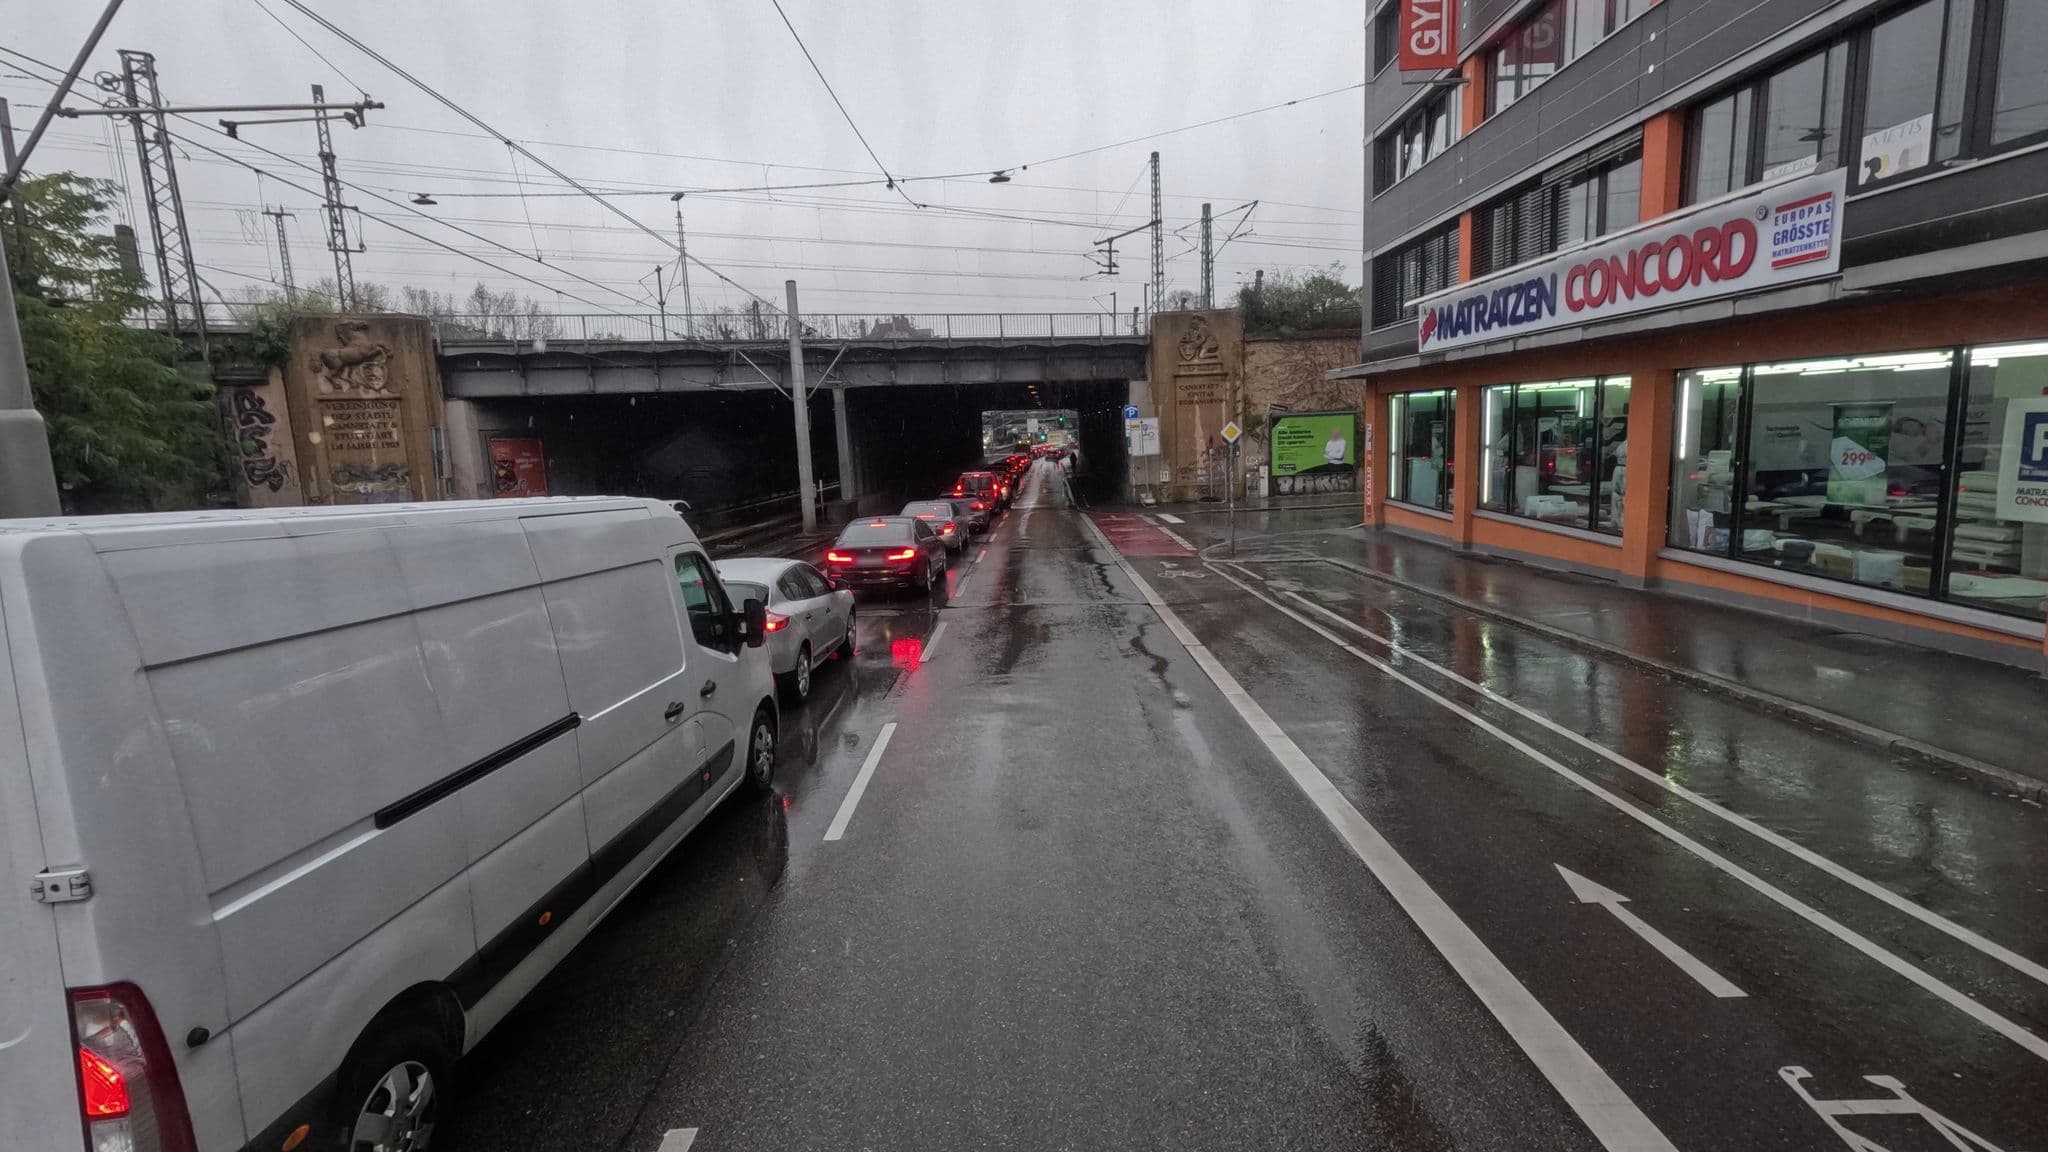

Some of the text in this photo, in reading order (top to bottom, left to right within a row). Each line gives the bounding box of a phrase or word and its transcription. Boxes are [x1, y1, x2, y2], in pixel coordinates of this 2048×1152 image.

[1410, 0, 1441, 56] GY
[1774, 201, 1832, 227] EUROPAS
[1773, 218, 1830, 246] GRÖSSTE
[1437, 217, 1758, 341] MATRATZEN CONCORD
[1128, 409, 1135, 418] P
